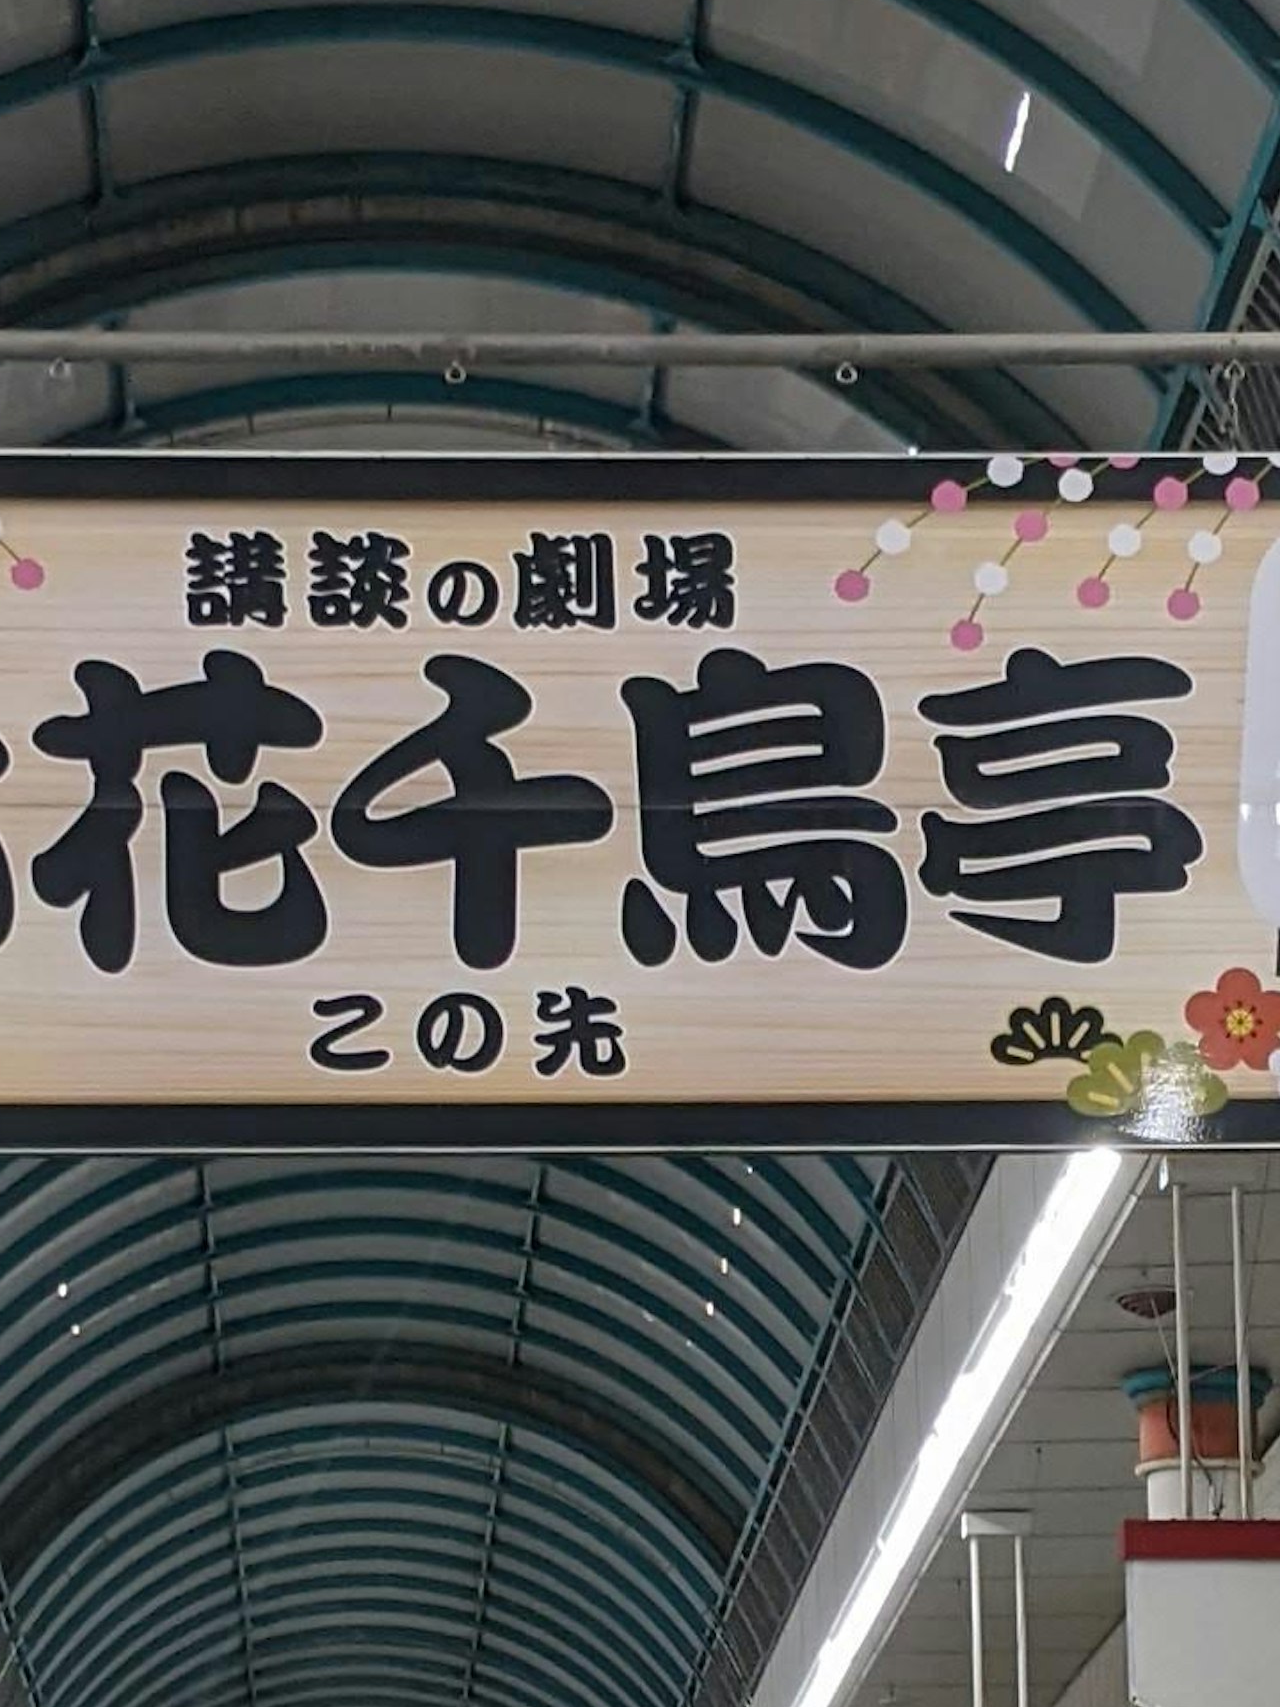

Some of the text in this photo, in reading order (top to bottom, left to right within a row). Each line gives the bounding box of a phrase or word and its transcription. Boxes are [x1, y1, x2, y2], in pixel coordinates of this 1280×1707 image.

[185, 531, 735, 629] 講談の劇場
[310, 988, 627, 1076] この先
